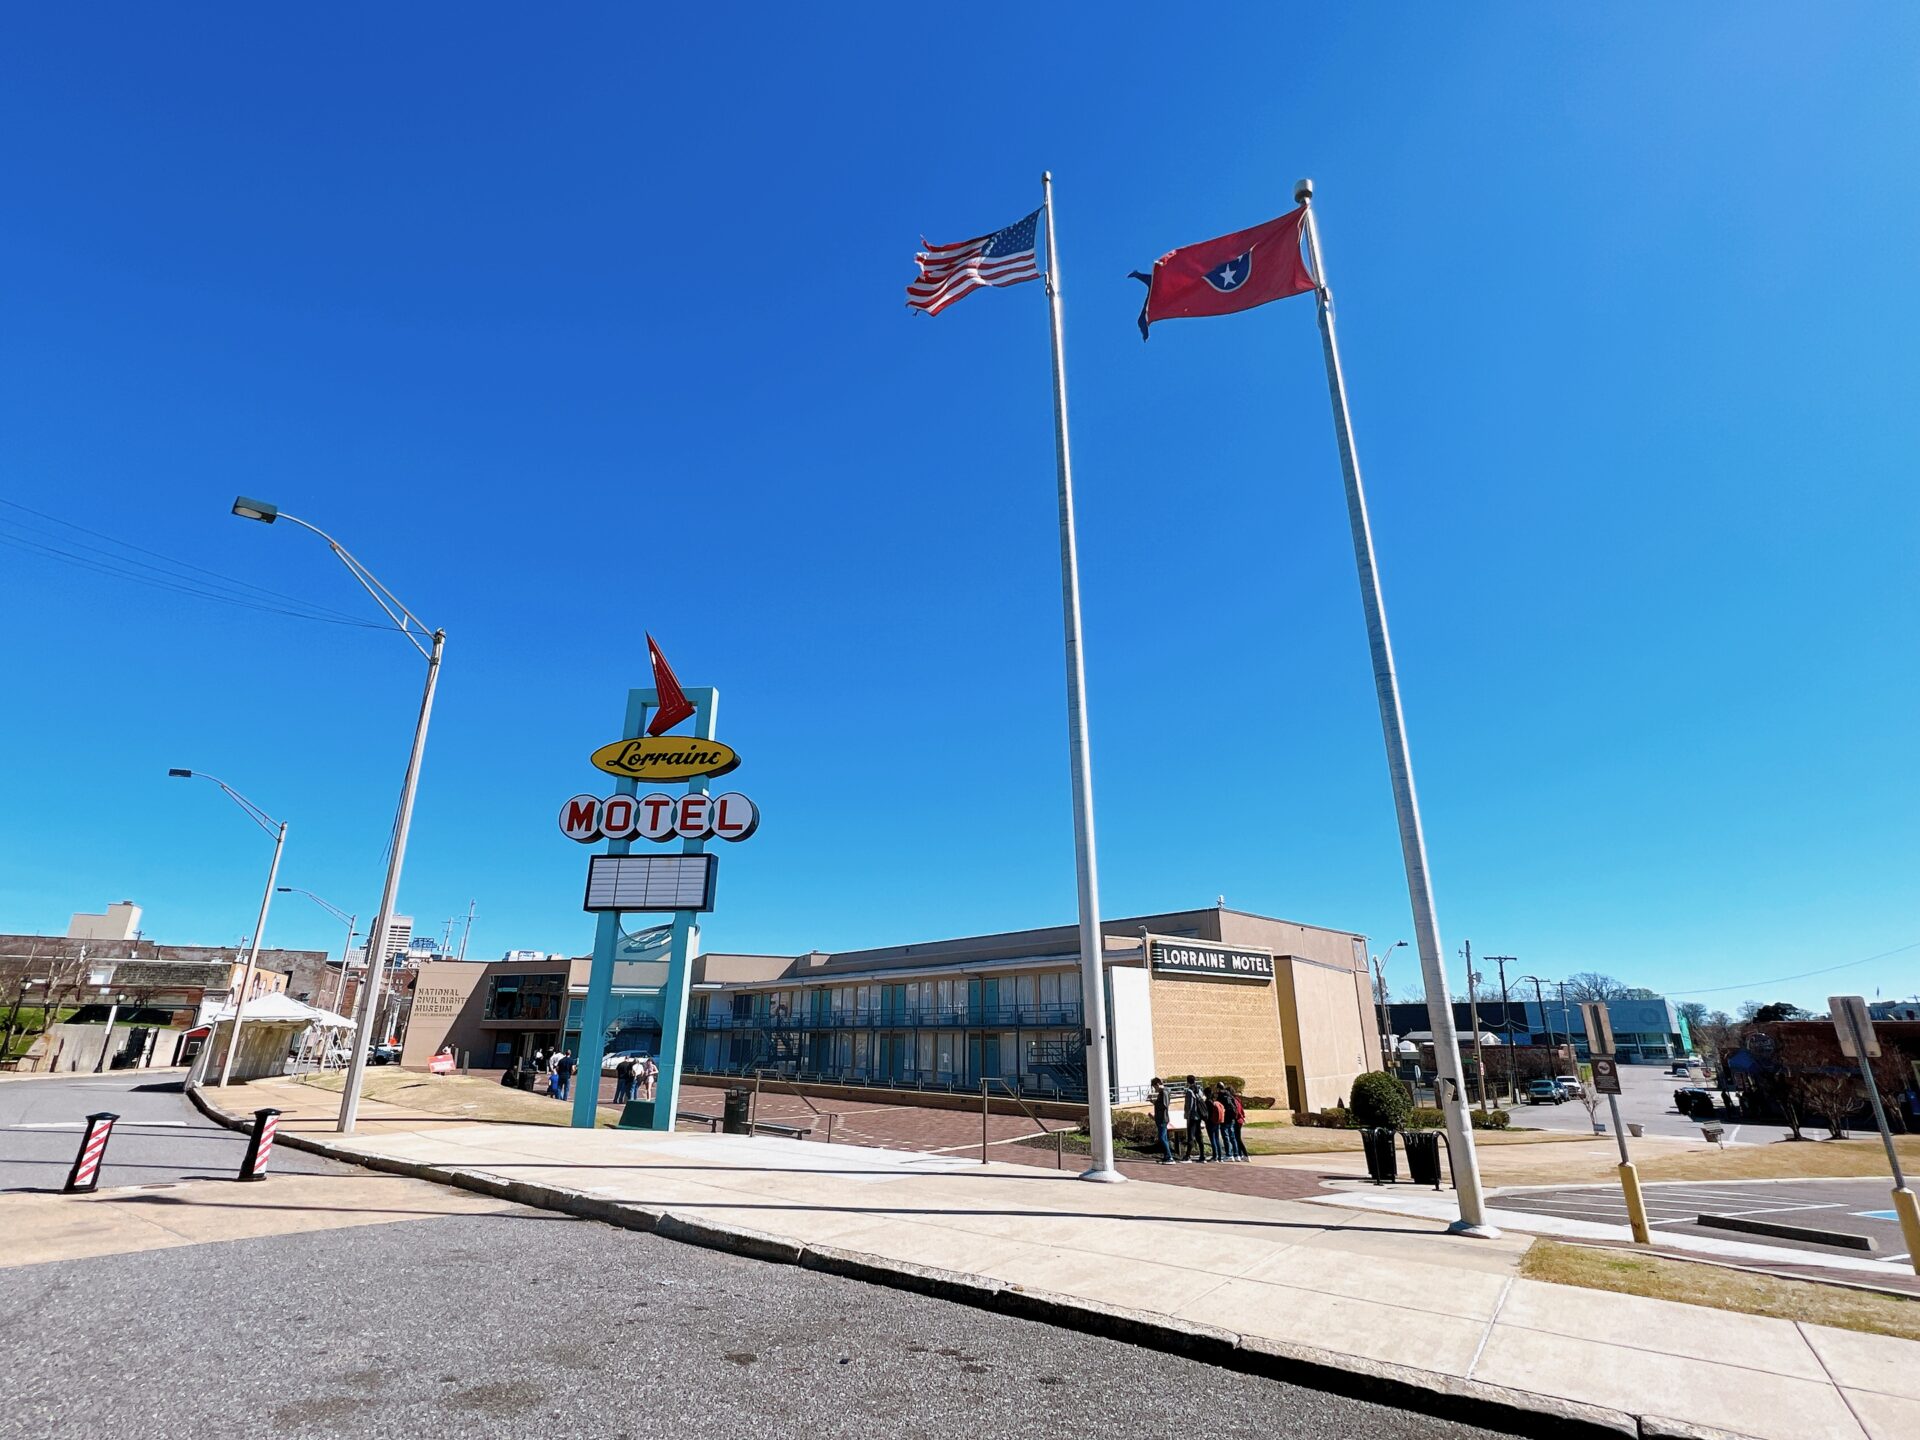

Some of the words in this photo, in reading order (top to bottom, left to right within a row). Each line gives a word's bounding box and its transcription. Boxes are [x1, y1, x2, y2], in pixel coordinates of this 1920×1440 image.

[605, 741, 721, 772] Lorraine
[566, 799, 743, 832] MOTEL
[1163, 948, 1226, 969] LORRAINE
[1231, 955, 1270, 973] MOTEL
[417, 996, 438, 1004] CIVIL
[418, 988, 460, 996] NATIONAL
[414, 1004, 453, 1013] MUSEUM
